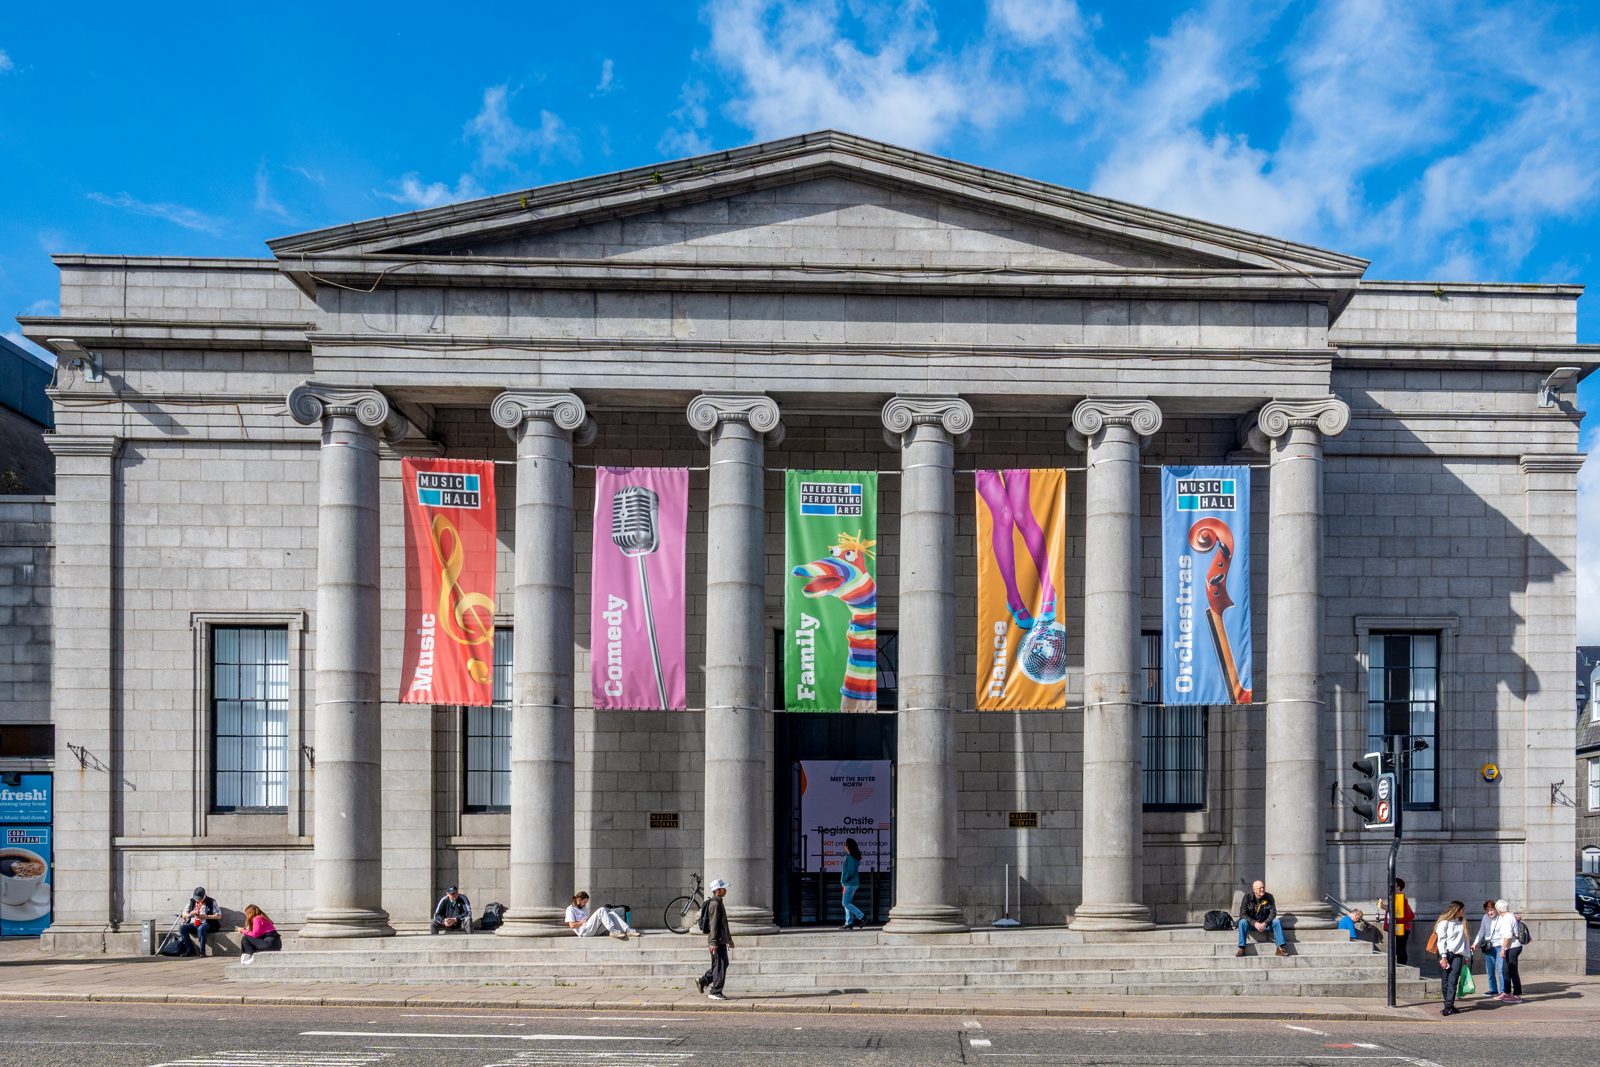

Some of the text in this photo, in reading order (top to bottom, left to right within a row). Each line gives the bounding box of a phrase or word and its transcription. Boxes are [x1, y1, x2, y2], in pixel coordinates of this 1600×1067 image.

[420, 475, 462, 488] MUSIC
[1180, 482, 1219, 493] MUSIC
[802, 485, 849, 494] ABERDEEN
[444, 492, 477, 505] HALL
[802, 496, 860, 504] PERFORMING
[1202, 497, 1233, 508] HALL
[1174, 554, 1192, 692] Orchestras
[602, 594, 628, 696] Comedy
[412, 613, 436, 692] Music
[796, 612, 820, 700] Family
[988, 621, 1008, 698] Dance
[0, 789, 47, 800] fresh!
[844, 816, 874, 825] Onsite
[818, 826, 874, 836] Registration
